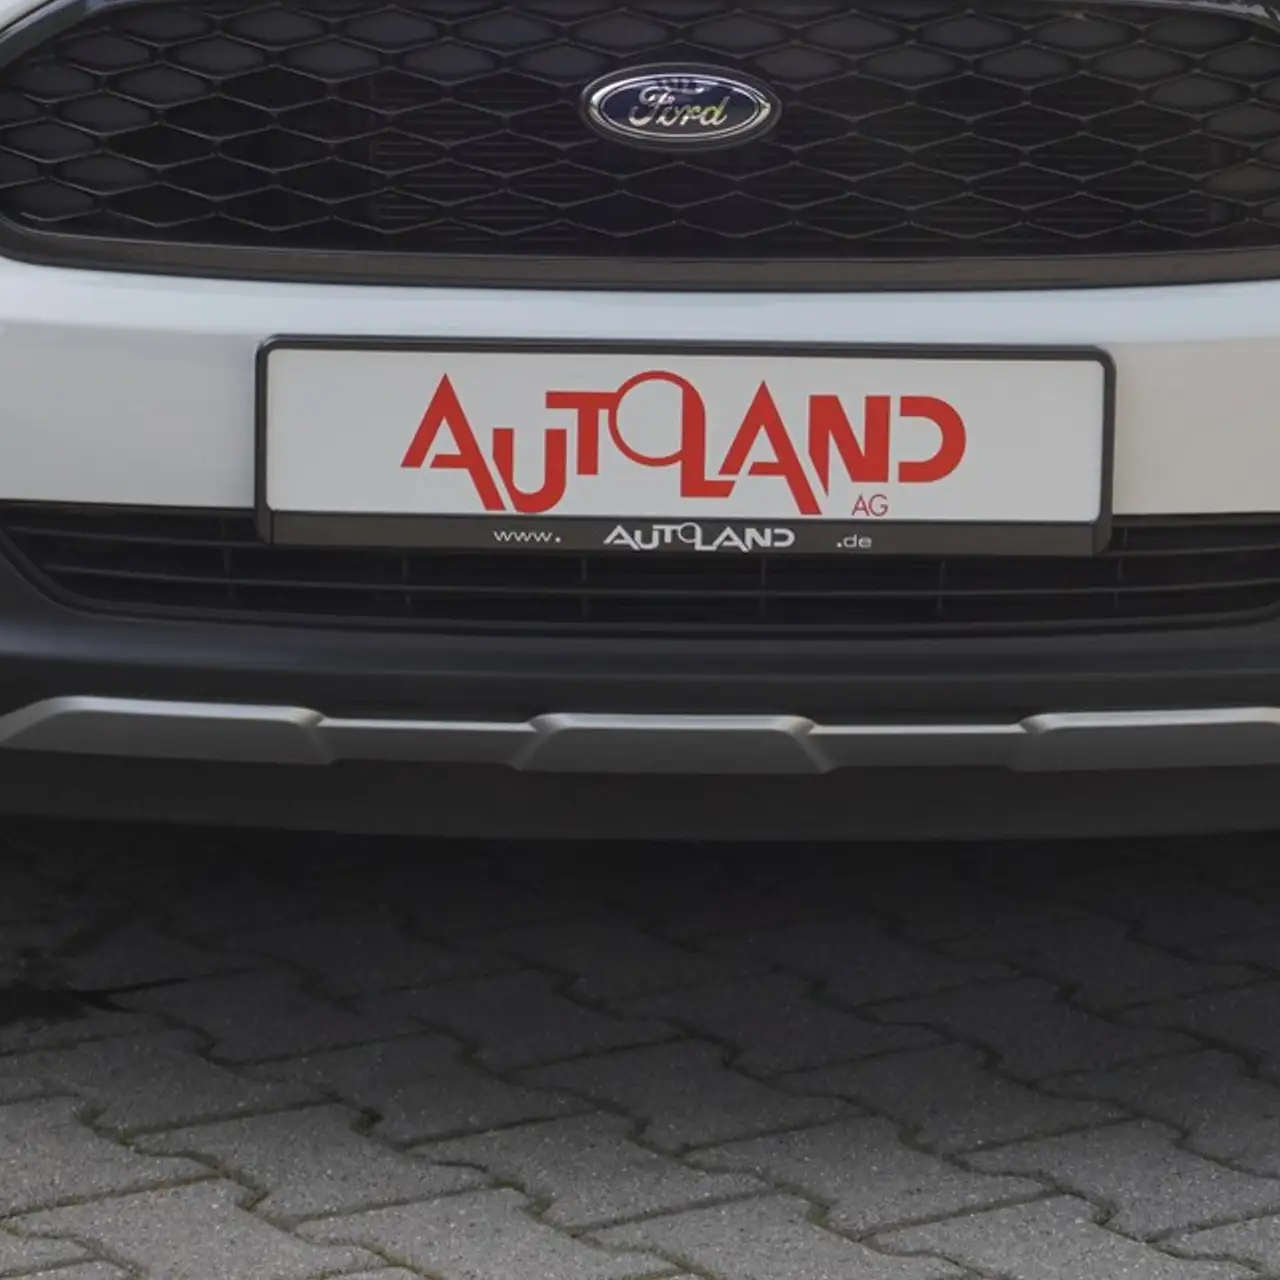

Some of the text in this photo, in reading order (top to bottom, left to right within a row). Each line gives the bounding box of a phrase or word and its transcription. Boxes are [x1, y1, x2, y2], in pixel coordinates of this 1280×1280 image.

[628, 84, 731, 127] Ford
[401, 371, 966, 516] AUTOLAND
[851, 493, 889, 517] AG
[493, 530, 562, 544] www.
[835, 534, 873, 550] .de
